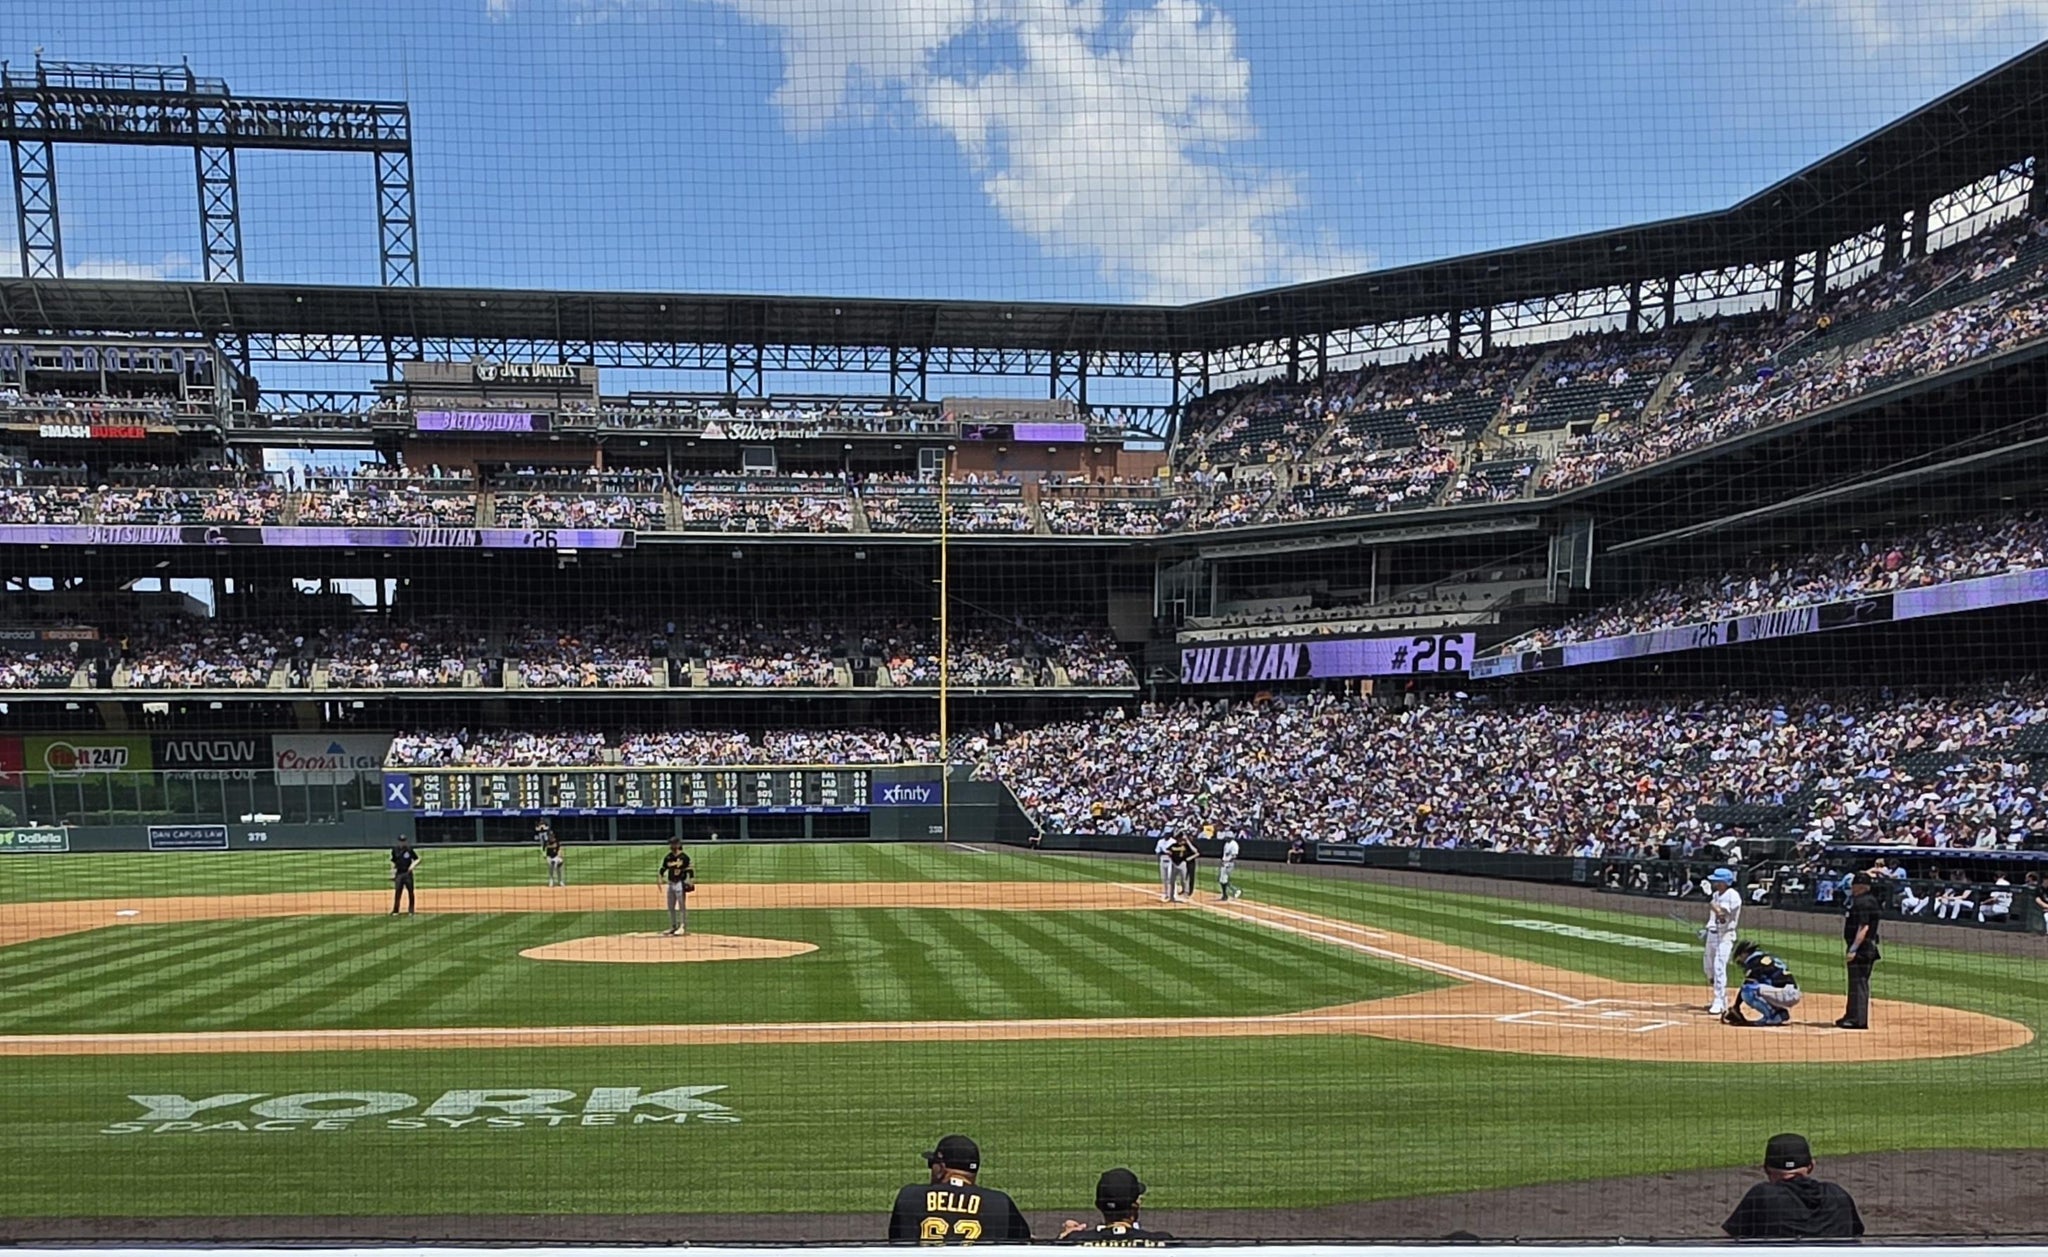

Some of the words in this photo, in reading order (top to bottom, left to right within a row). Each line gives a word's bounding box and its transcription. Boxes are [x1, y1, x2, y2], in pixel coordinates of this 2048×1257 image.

[478, 412, 531, 431] SULLIVAN
[407, 529, 477, 548] SULLIVAN
[1181, 643, 1300, 684] SULLIVAN
[1391, 635, 1464, 673] #26
[93, 749, 126, 764] 24/7
[165, 741, 255, 762] ARROW
[276, 749, 338, 772] Coors
[340, 756, 383, 769] LIGH
[756, 772, 772, 780] LAA
[821, 780, 837, 788] LAD
[757, 789, 774, 798] BOS
[883, 784, 931, 804] xfinity
[17, 832, 61, 844] DaBella
[152, 831, 170, 839] DAN
[204, 831, 224, 839] LAW
[127, 1085, 731, 1121] YORK
[100, 1117, 349, 1136] SPACE
[386, 1111, 743, 1130] SYSTEMS
[926, 1191, 981, 1214] BELLO
